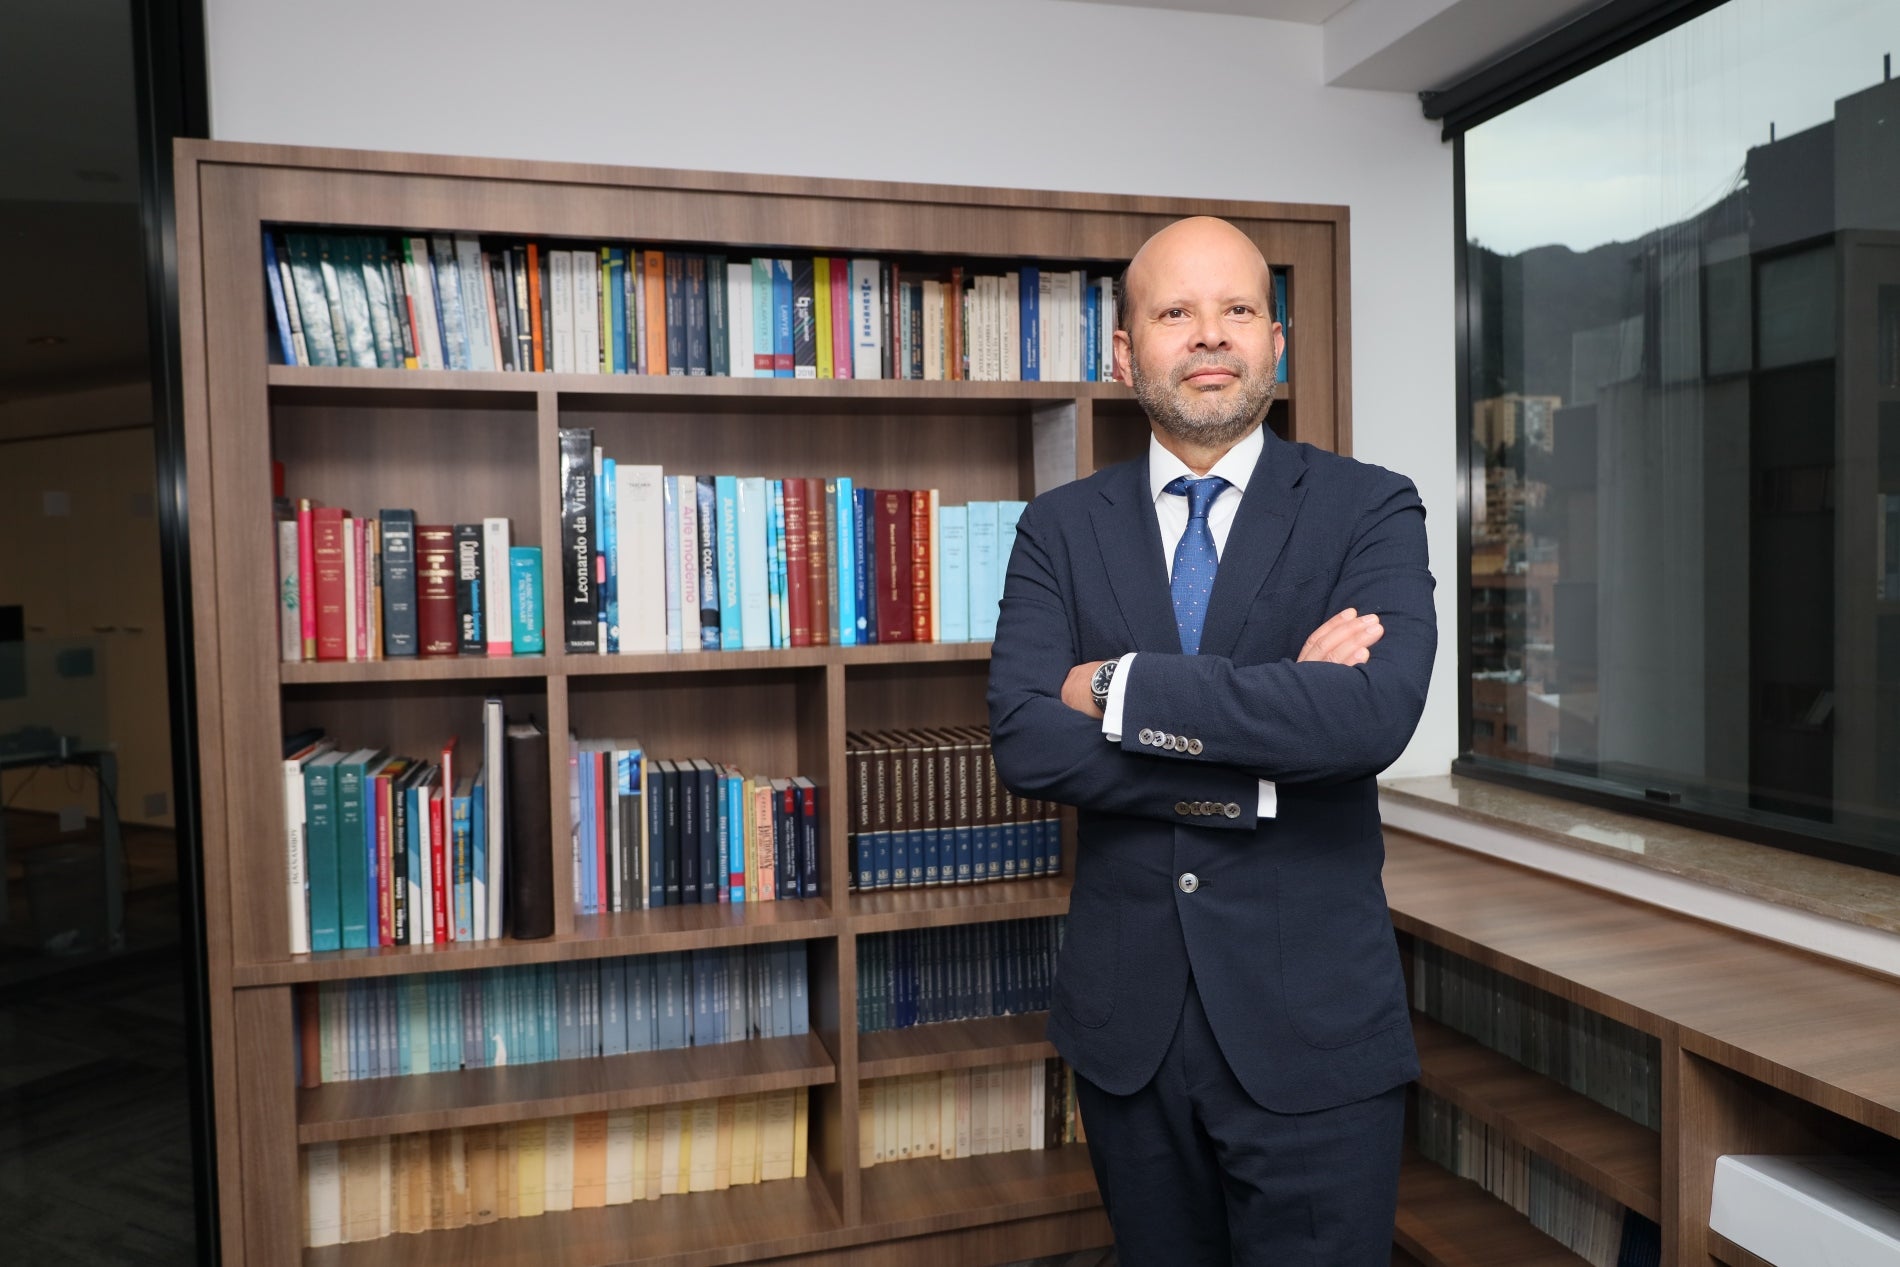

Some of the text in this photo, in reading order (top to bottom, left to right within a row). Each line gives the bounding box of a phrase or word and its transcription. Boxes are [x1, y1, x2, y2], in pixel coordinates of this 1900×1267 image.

[781, 304, 789, 336] LAWYER
[572, 475, 586, 514] Vinci
[573, 516, 587, 534] da
[701, 502, 713, 602] unseen COLOMBIA
[459, 540, 480, 580] Colombia
[573, 536, 589, 604] Leonardo
[683, 506, 697, 603] Arte moderno
[723, 497, 737, 608] JUAN MONTOYA
